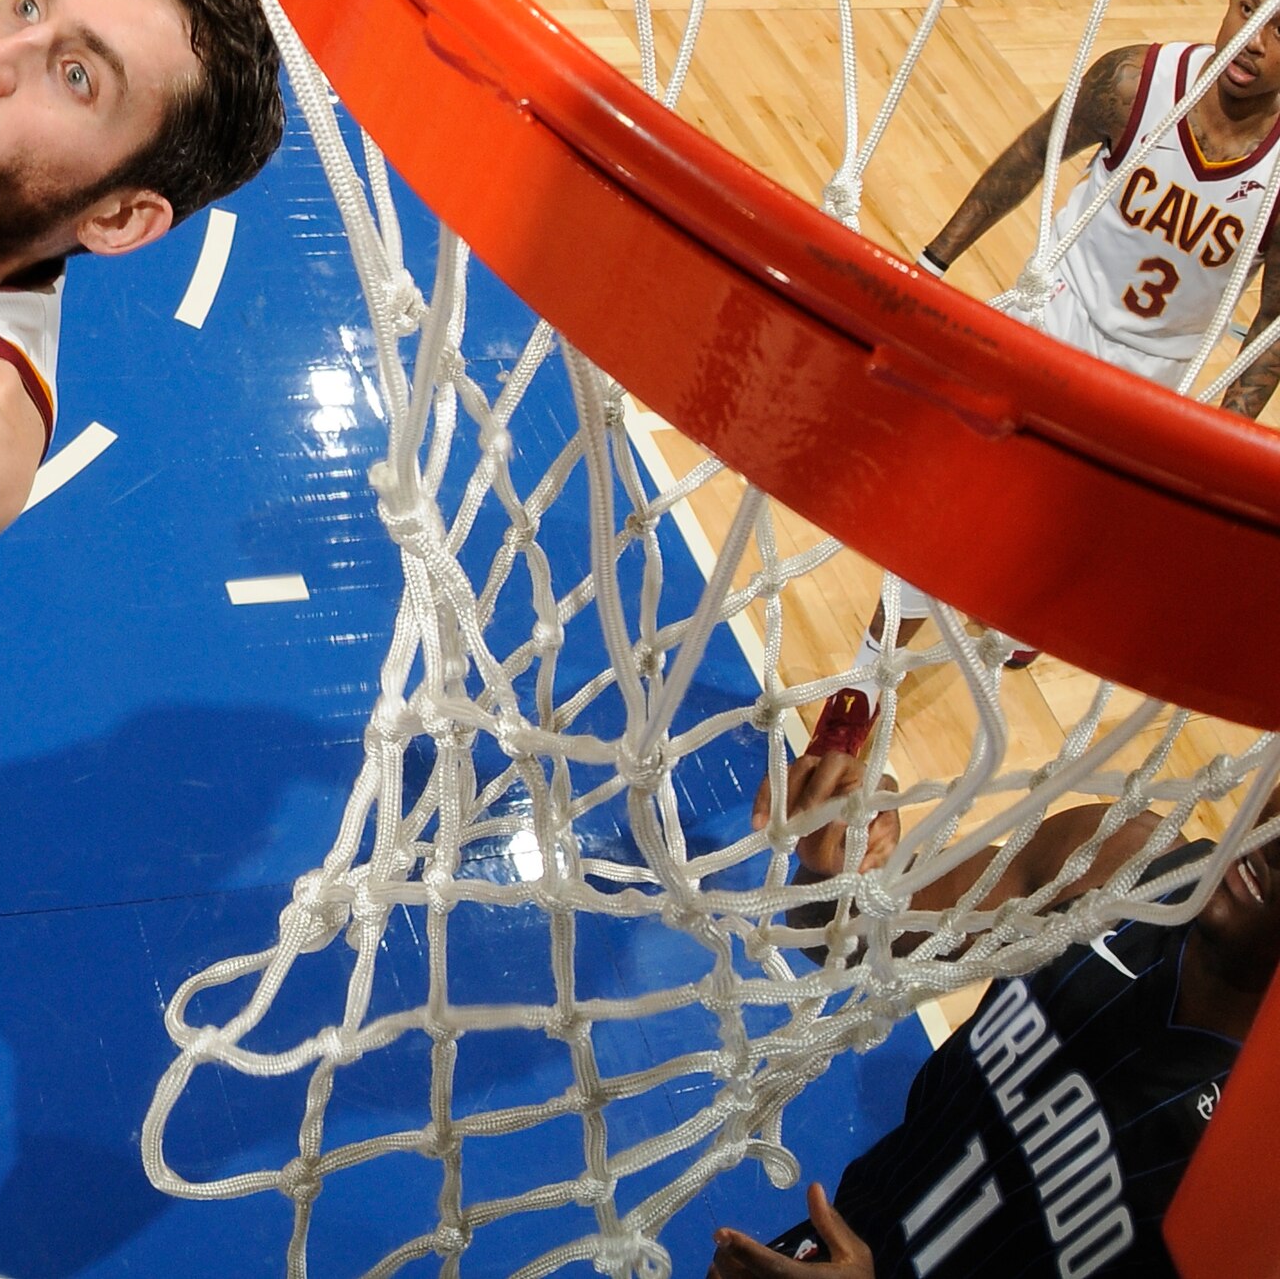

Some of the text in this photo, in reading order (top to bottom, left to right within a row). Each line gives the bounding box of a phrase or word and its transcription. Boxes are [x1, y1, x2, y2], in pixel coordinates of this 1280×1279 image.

[1118, 167, 1247, 270] CAVS
[1122, 256, 1182, 321] 3
[968, 978, 1136, 1279] ORLANDO
[901, 1133, 1006, 1279] 11
